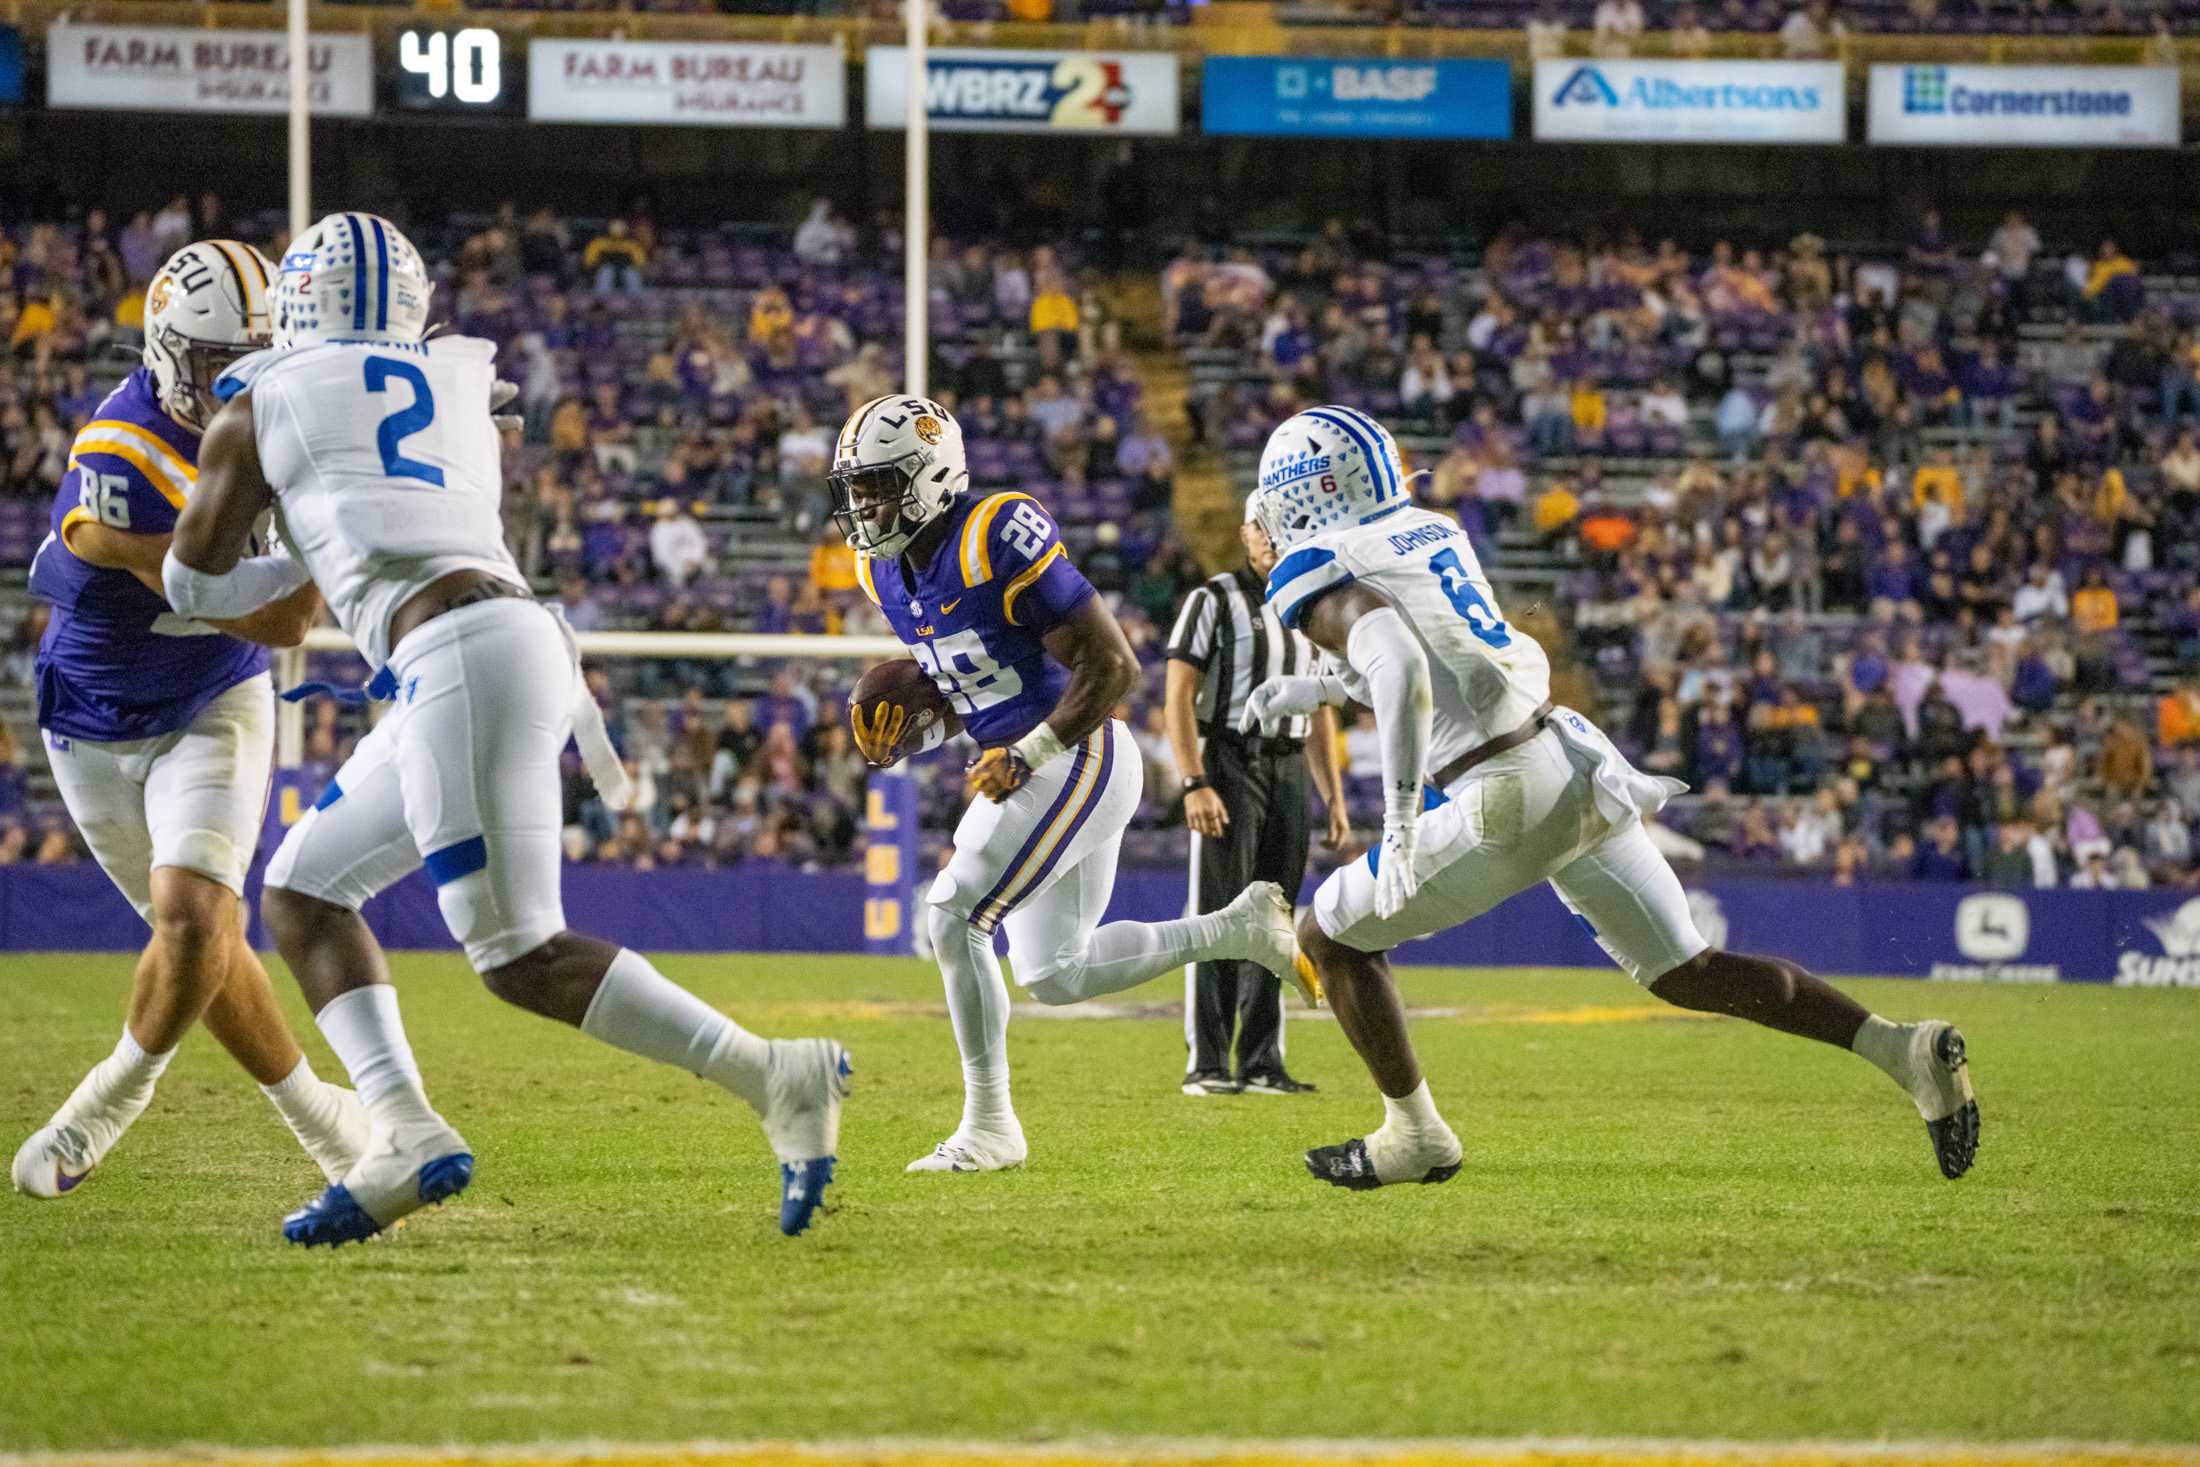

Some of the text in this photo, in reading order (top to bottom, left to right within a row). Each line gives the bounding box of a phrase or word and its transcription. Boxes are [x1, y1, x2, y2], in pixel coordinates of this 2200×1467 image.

[84, 37, 331, 73] FARM BUREU
[401, 28, 500, 102] 40
[564, 51, 804, 83] FARM BUREAU
[1332, 66, 1438, 101] BASF
[1630, 78, 1820, 111] Albertsons
[1950, 86, 2131, 116] Cornerstone
[298, 272, 312, 295] 2
[362, 355, 446, 488] 2
[879, 400, 949, 430] LSU
[79, 464, 131, 528] 86
[1321, 475, 1337, 493] 6
[1000, 502, 1052, 561] 28
[1387, 523, 1459, 556] JOHNSON
[1429, 547, 1512, 649] 6
[909, 629, 1023, 715] 28
